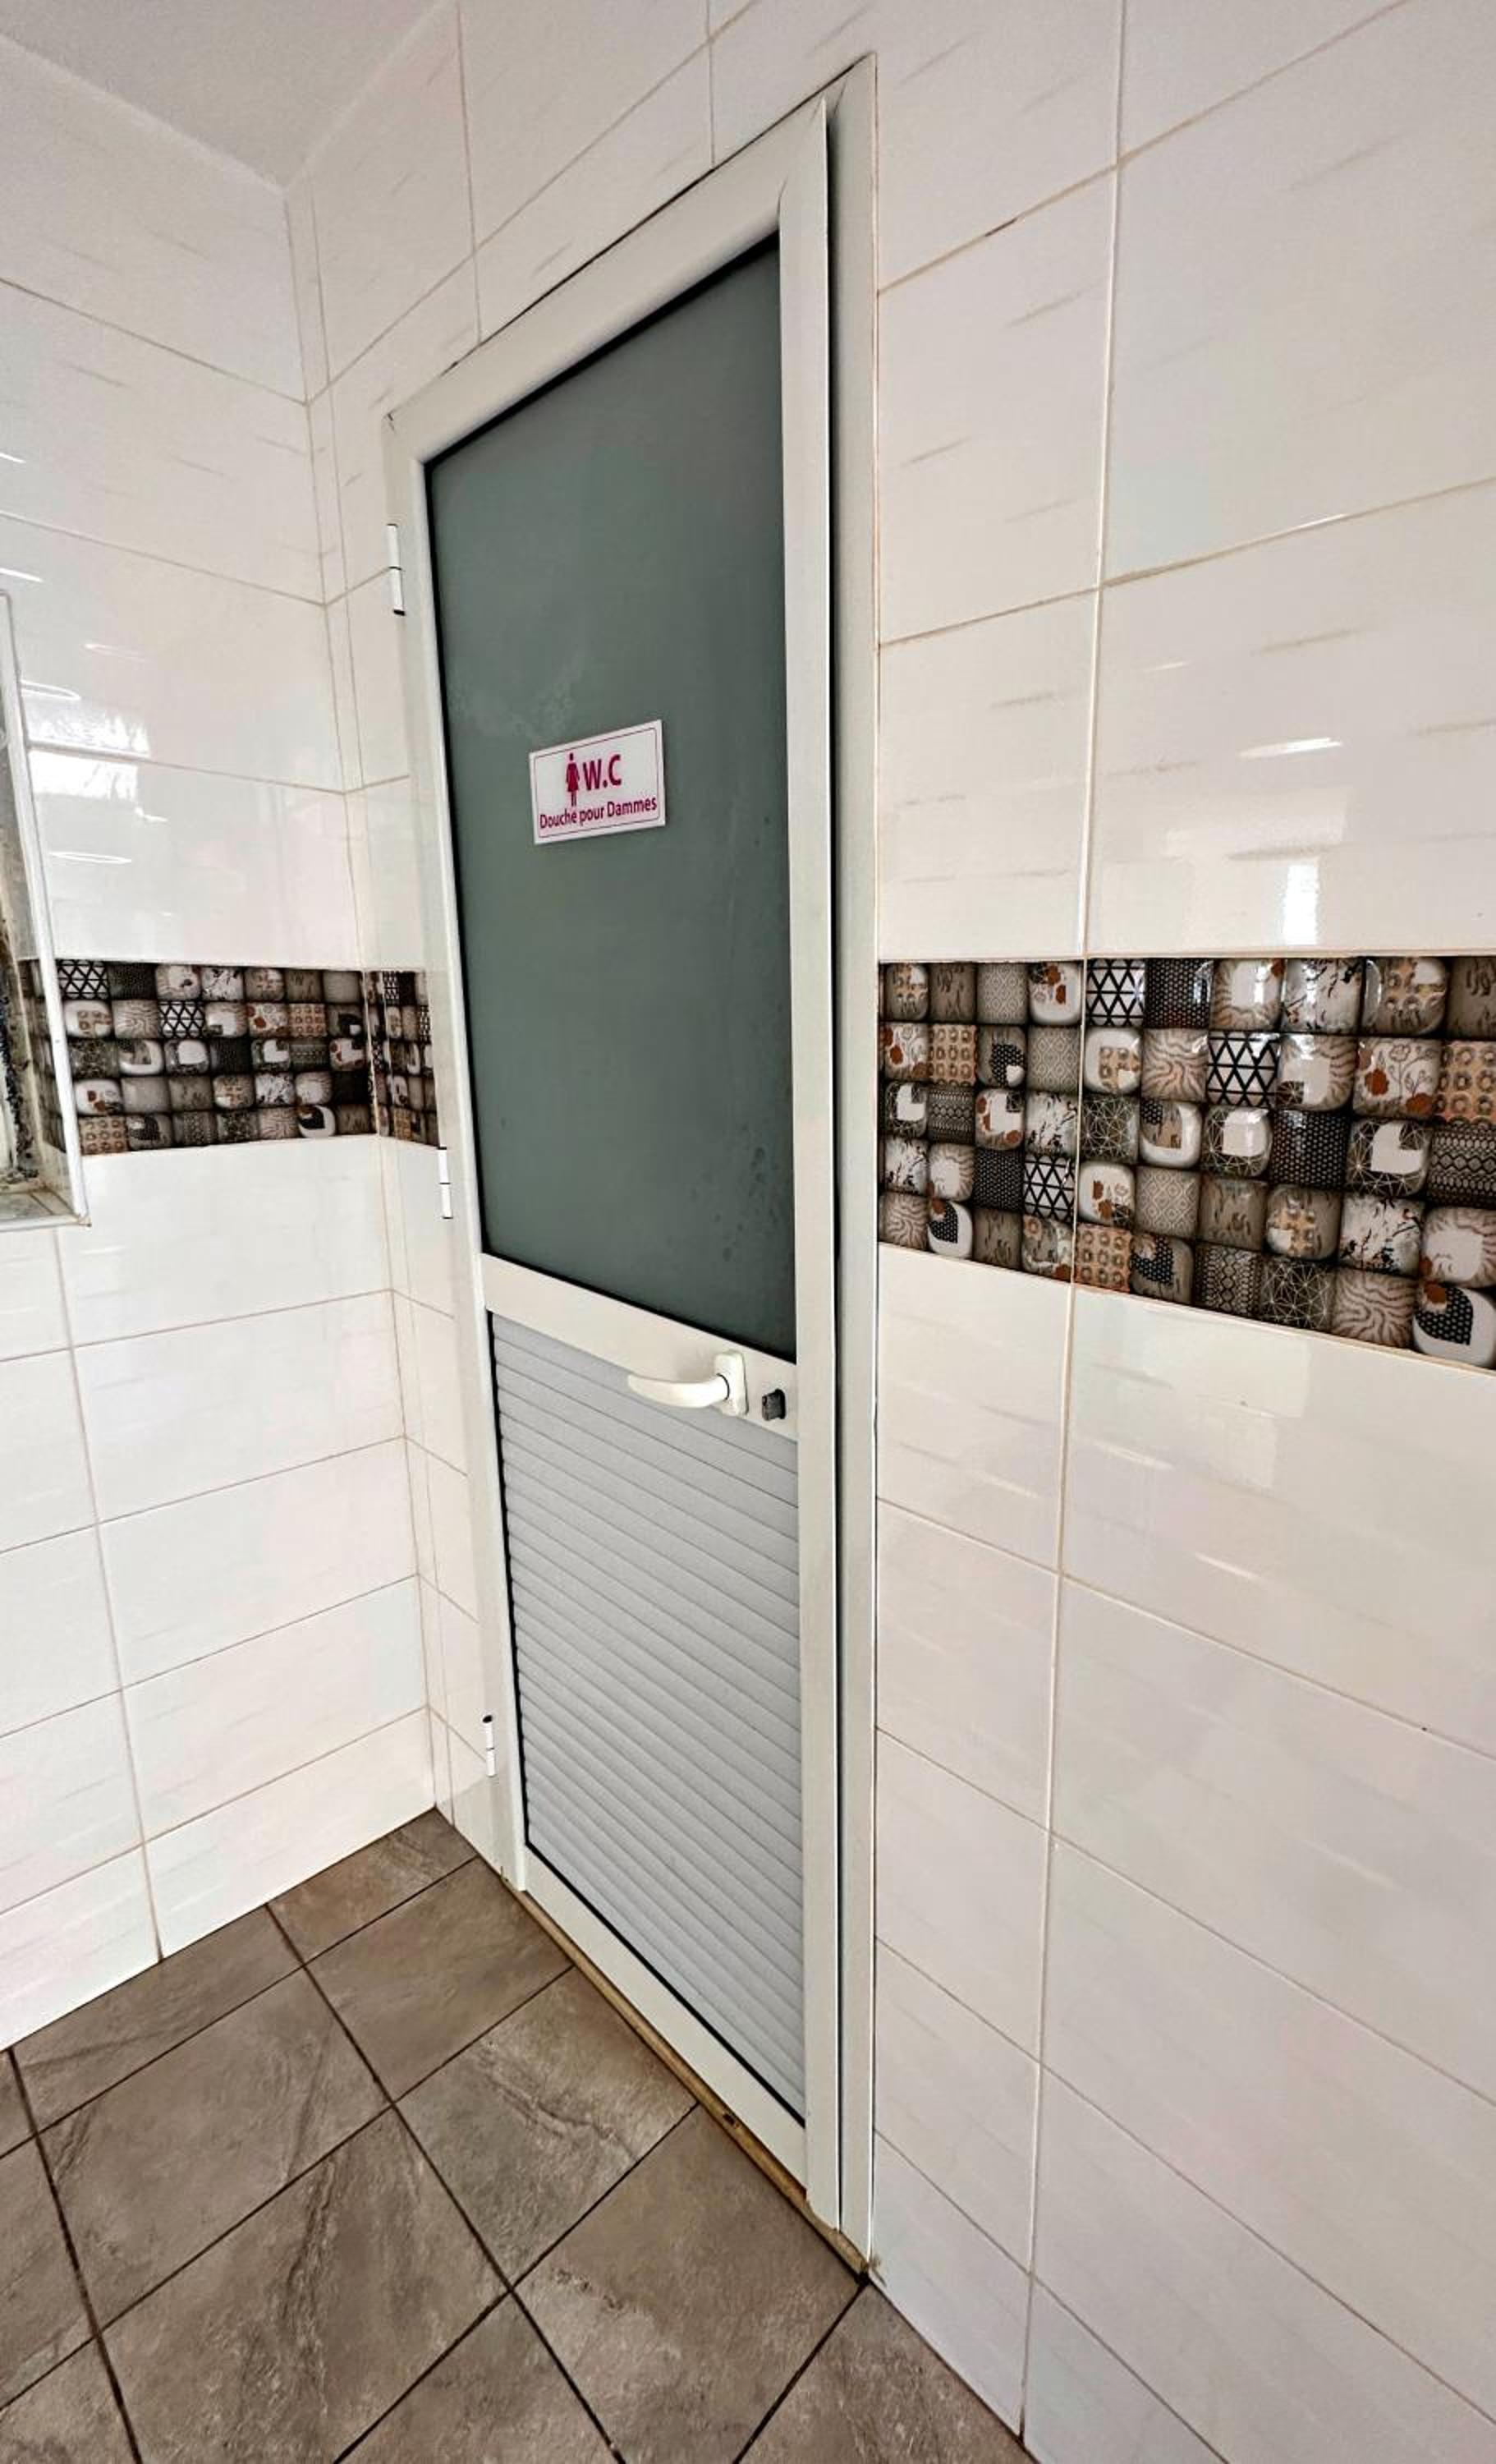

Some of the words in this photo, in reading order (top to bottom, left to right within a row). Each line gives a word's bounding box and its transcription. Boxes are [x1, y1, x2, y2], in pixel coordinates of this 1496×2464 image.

[582, 753, 622, 792] W.C
[539, 808, 577, 830] Douche
[579, 805, 605, 826] pour
[607, 797, 658, 818] Dammes
